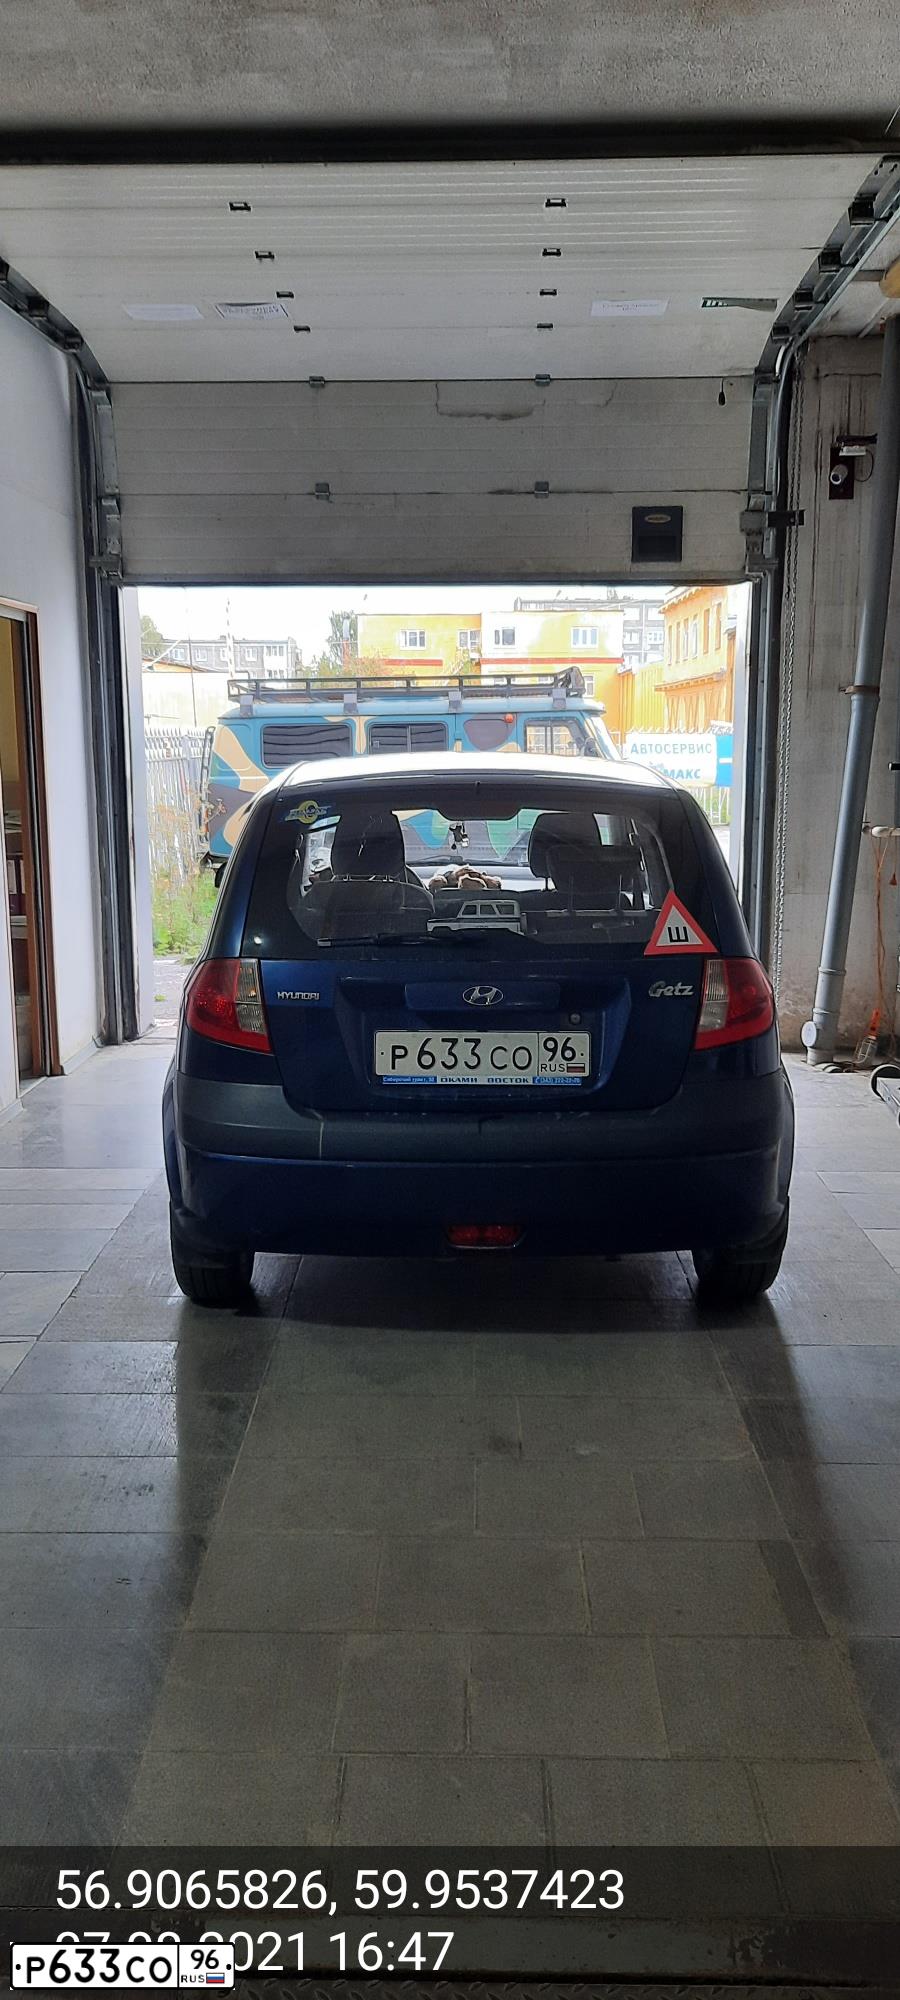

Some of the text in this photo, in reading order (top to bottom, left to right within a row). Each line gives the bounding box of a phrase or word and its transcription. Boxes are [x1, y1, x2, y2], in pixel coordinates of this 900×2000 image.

[630, 743, 712, 754] АВТОСЕРВИС
[668, 926, 689, 942] Ш
[648, 980, 694, 997] Getz
[277, 991, 320, 1000] HYUNDAI
[543, 1037, 577, 1062] 96
[540, 1063, 566, 1073] RUS
